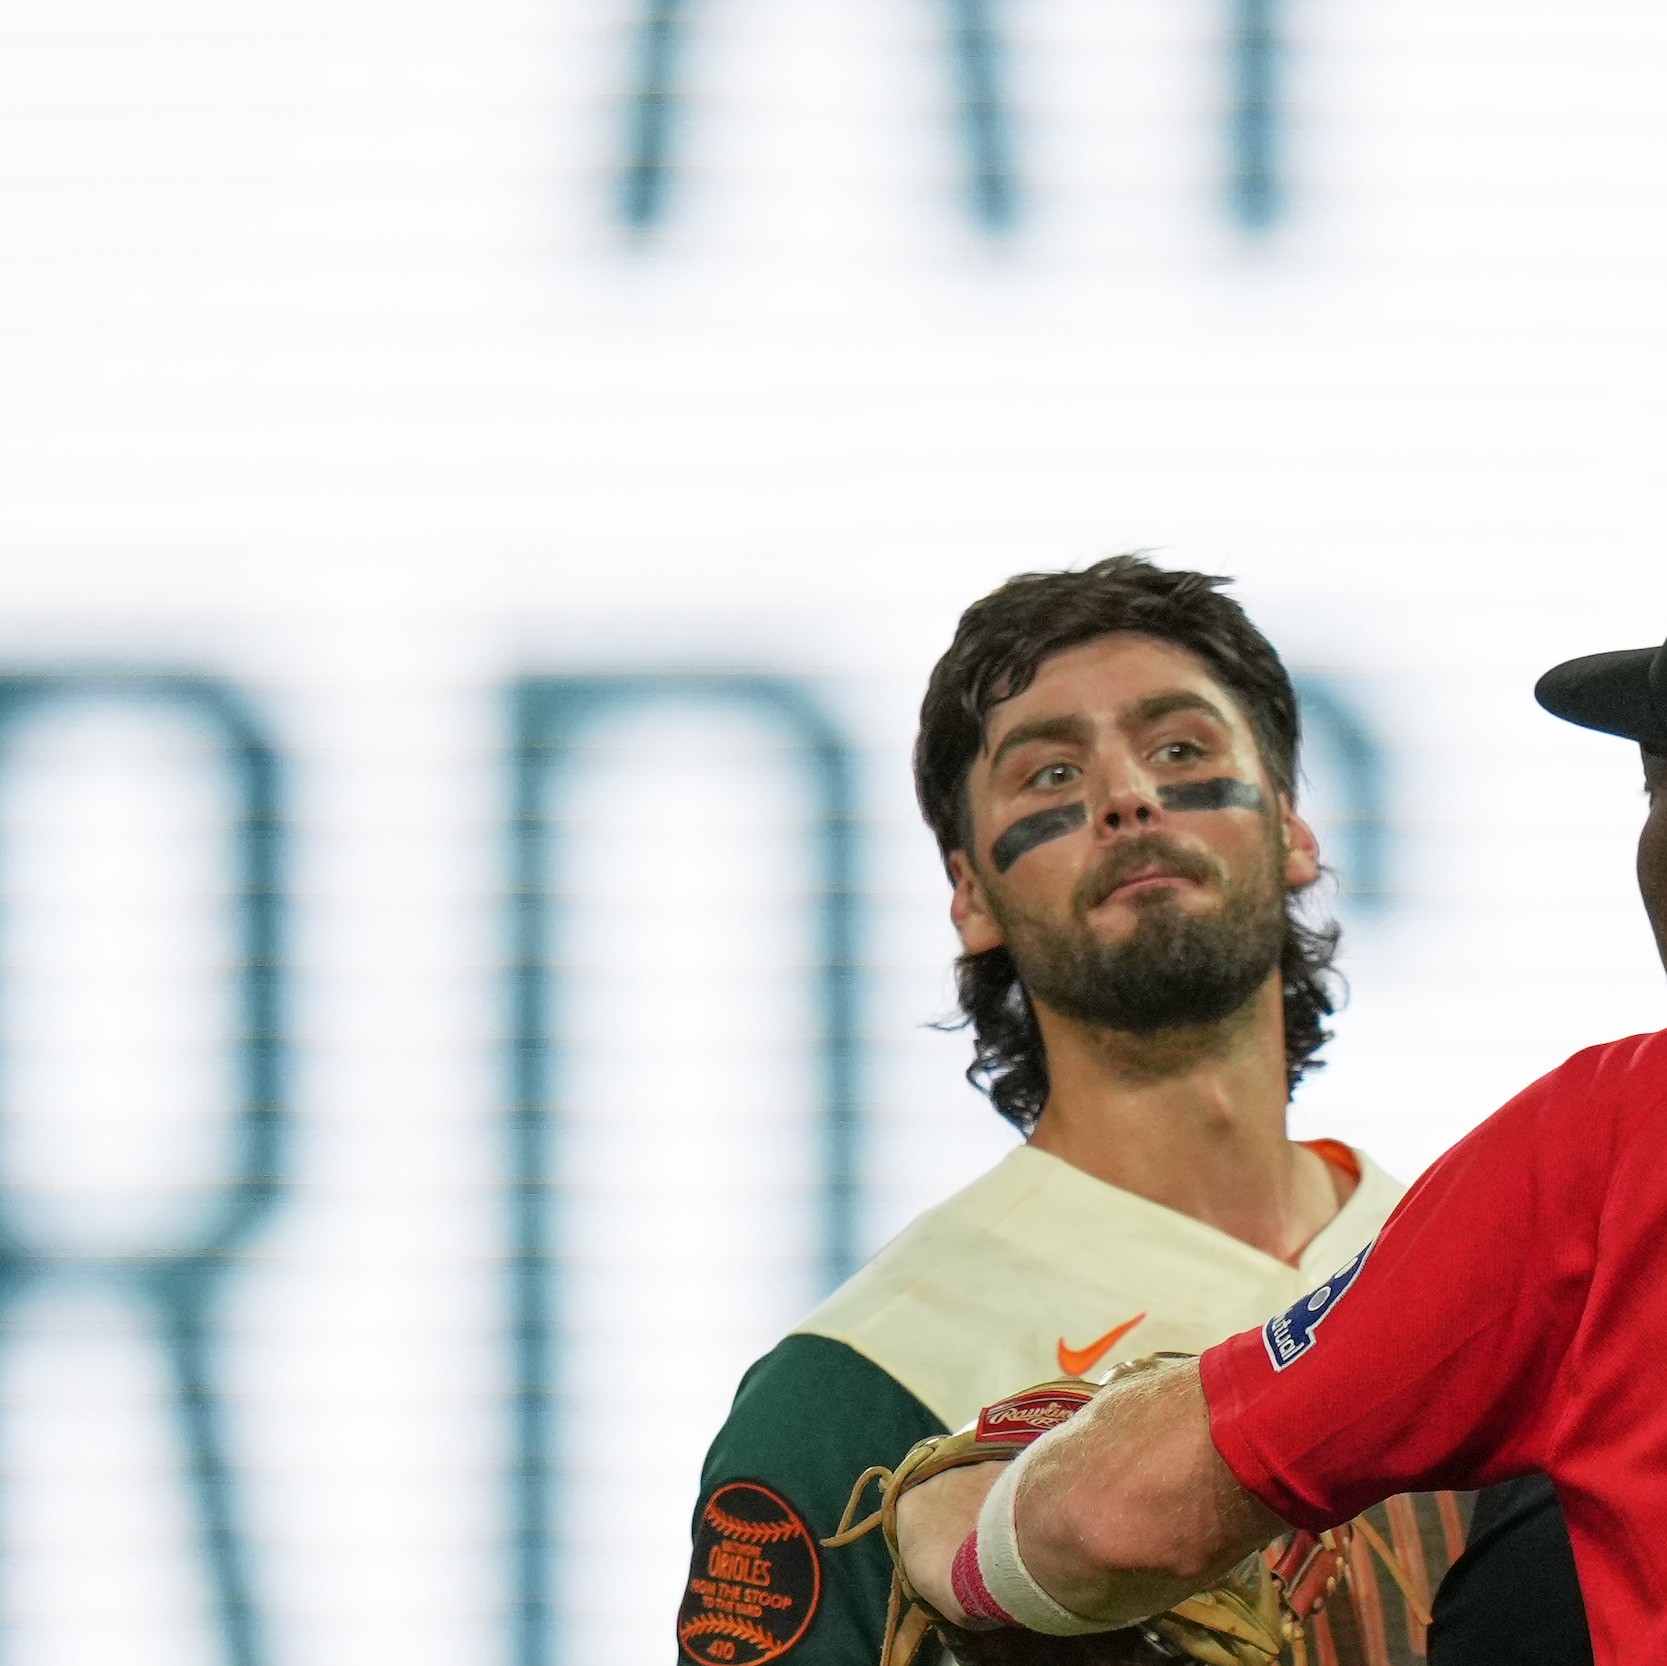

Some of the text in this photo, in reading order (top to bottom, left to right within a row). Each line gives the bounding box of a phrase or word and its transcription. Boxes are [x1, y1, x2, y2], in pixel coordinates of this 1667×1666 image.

[985, 1401, 1075, 1425] Rawlin
[708, 1544, 772, 1587] ORIOLES
[744, 1587, 793, 1610] STOOP
